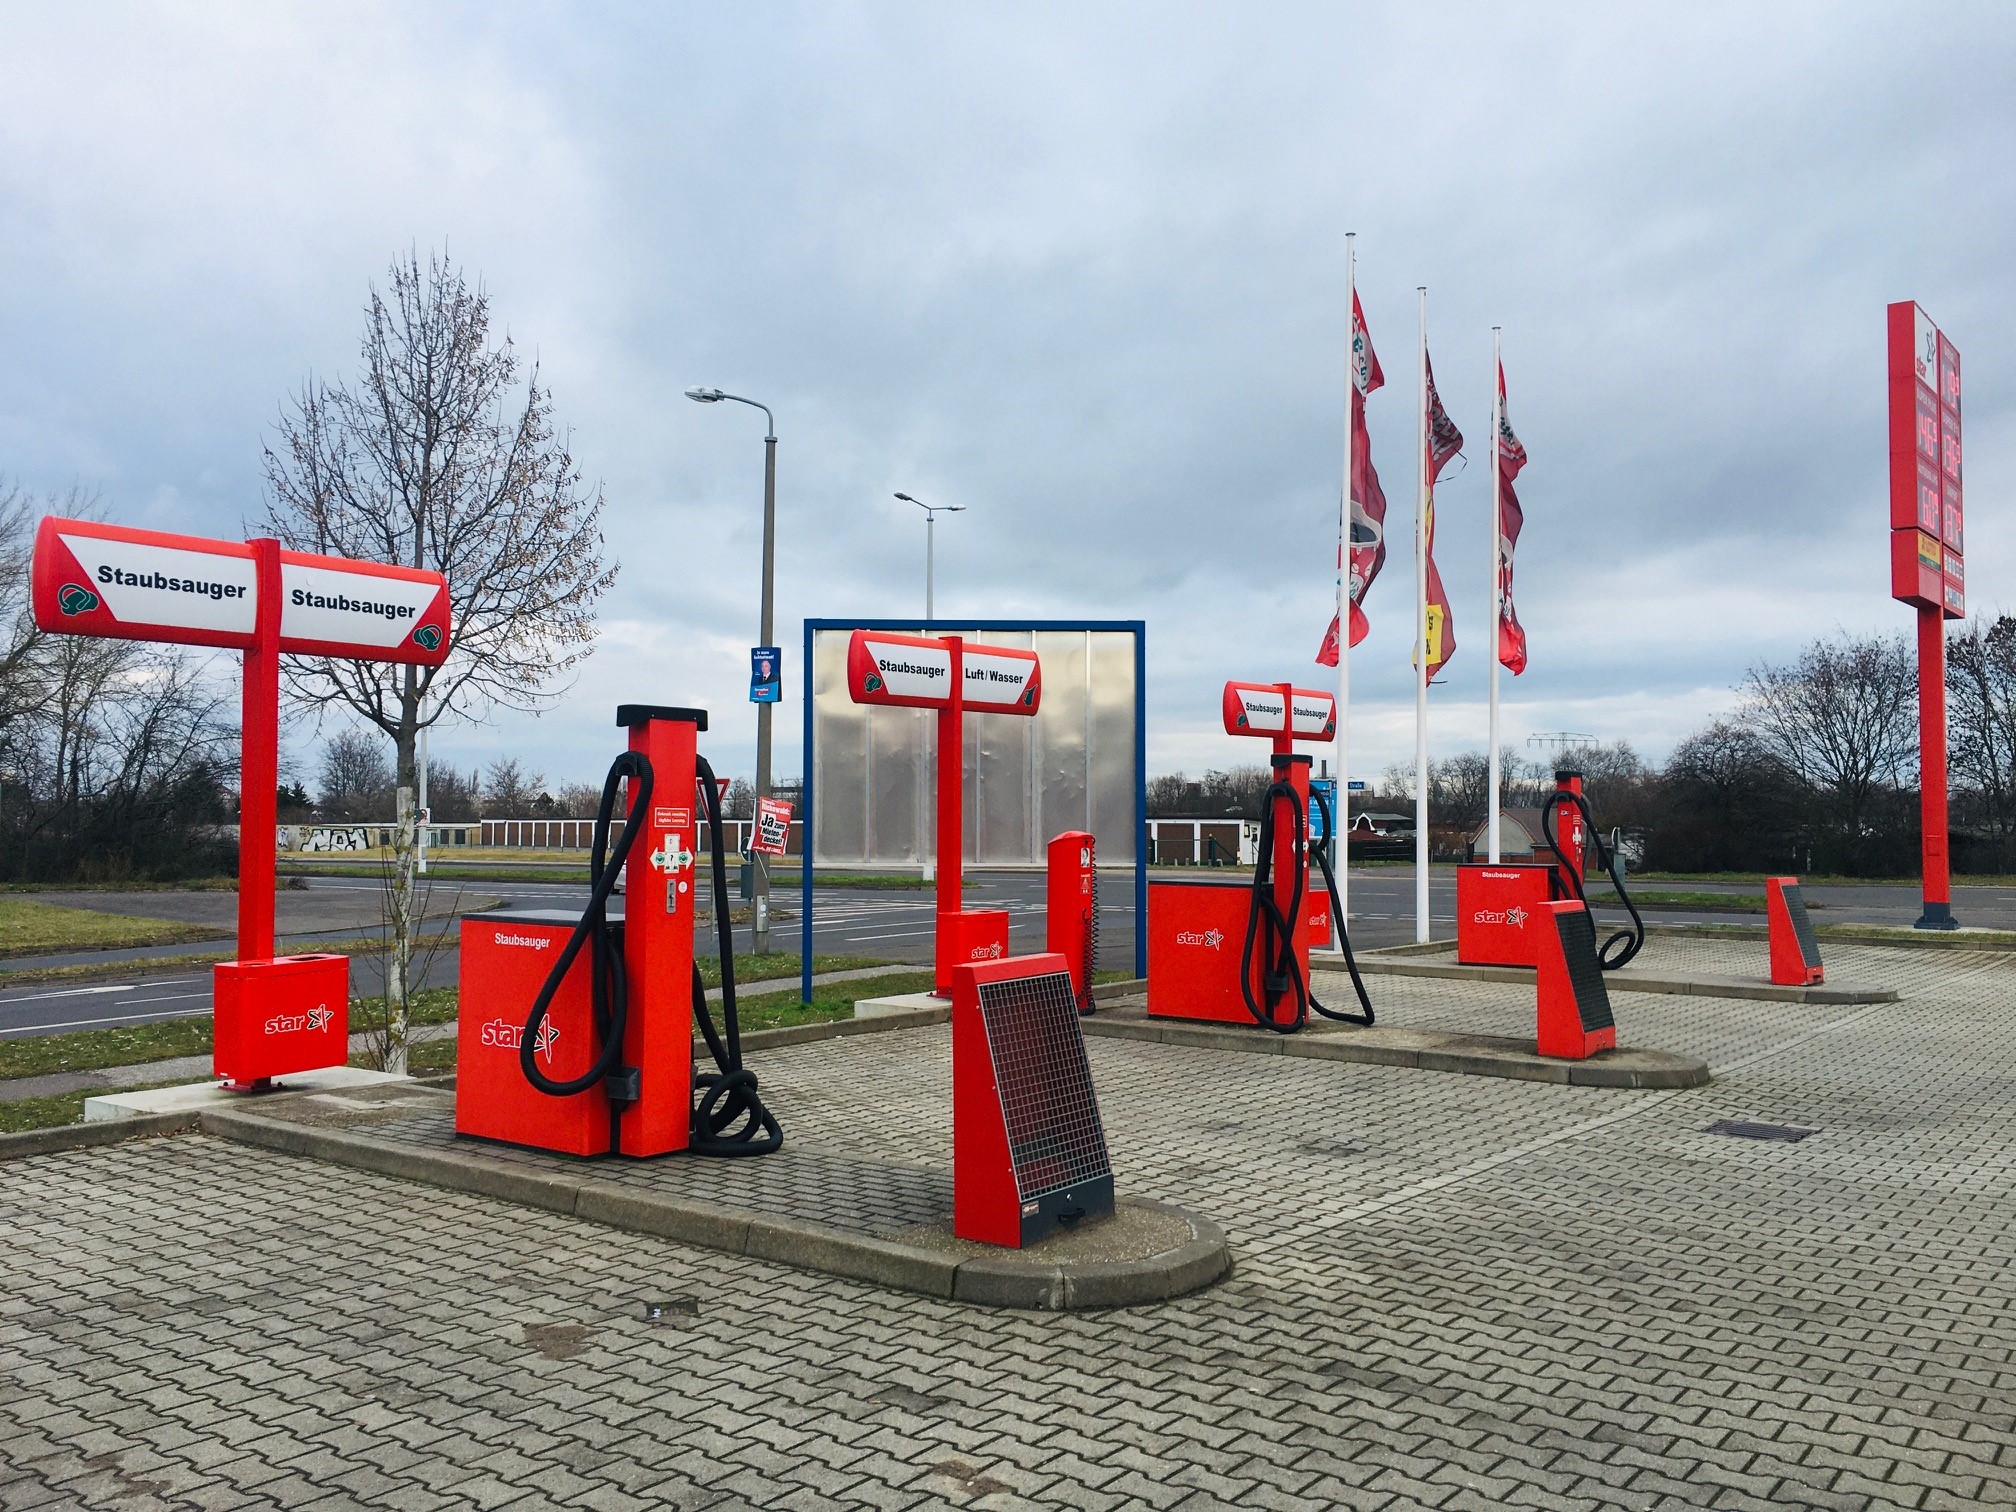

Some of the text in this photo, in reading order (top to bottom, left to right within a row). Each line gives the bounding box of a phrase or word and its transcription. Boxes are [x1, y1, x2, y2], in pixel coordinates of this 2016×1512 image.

[97, 565, 247, 600] Staubsauger
[291, 588, 416, 620] Staubsauger
[879, 659, 945, 679] Staubsauger
[1245, 701, 1283, 716] Staubsauger
[1293, 706, 1328, 719] Staubsauger
[761, 813, 775, 827] Ja
[1481, 871, 1521, 879] Staubsauger
[1474, 910, 1506, 924] star
[495, 932, 551, 950] Staubsauger
[1177, 930, 1204, 945] star
[971, 945, 990, 959] star
[265, 1014, 305, 1034] star
[481, 1018, 527, 1049] star
